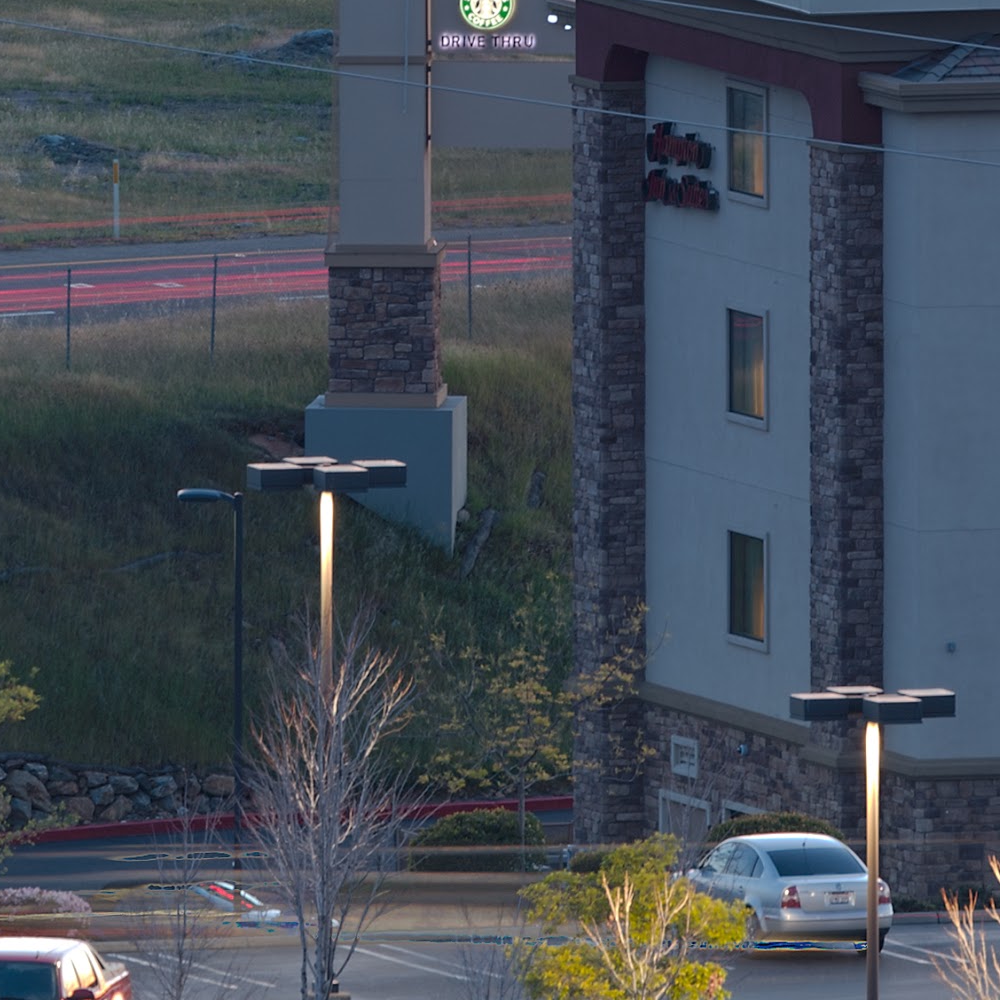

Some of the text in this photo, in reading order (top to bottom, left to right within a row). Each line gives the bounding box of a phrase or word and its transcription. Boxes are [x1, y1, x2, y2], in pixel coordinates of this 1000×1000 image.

[467, 13, 504, 27] COFFEE
[441, 35, 535, 48] DRIVE THRU
